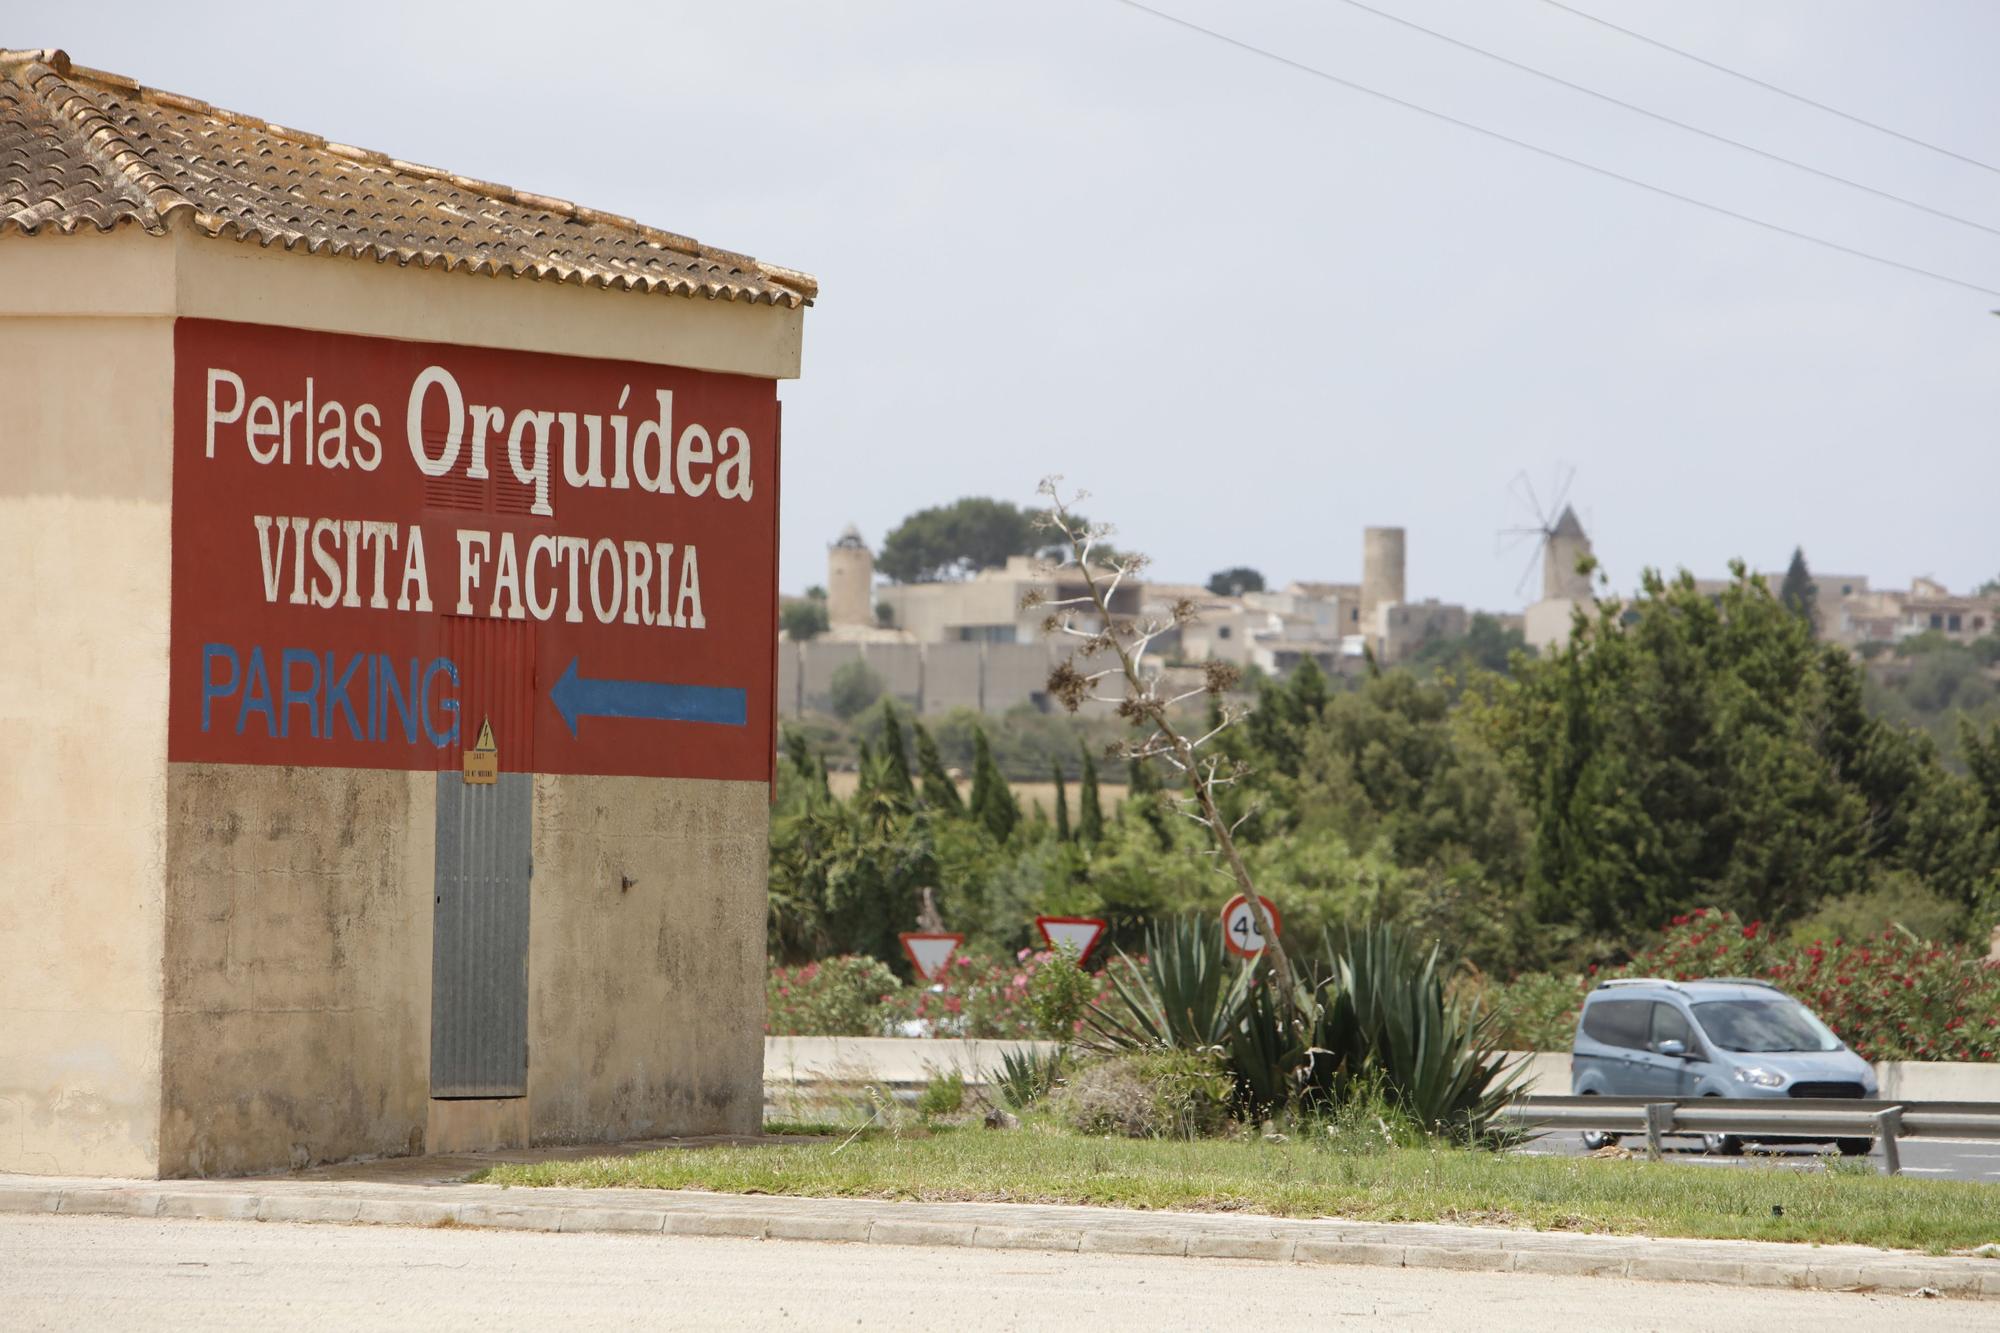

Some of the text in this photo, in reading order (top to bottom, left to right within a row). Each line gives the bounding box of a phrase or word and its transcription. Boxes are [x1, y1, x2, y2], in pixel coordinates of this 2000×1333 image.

[205, 365, 753, 517] Perlas Orquídea
[253, 515, 706, 630] VISITA FACTORIA
[201, 643, 460, 749] PARKING
